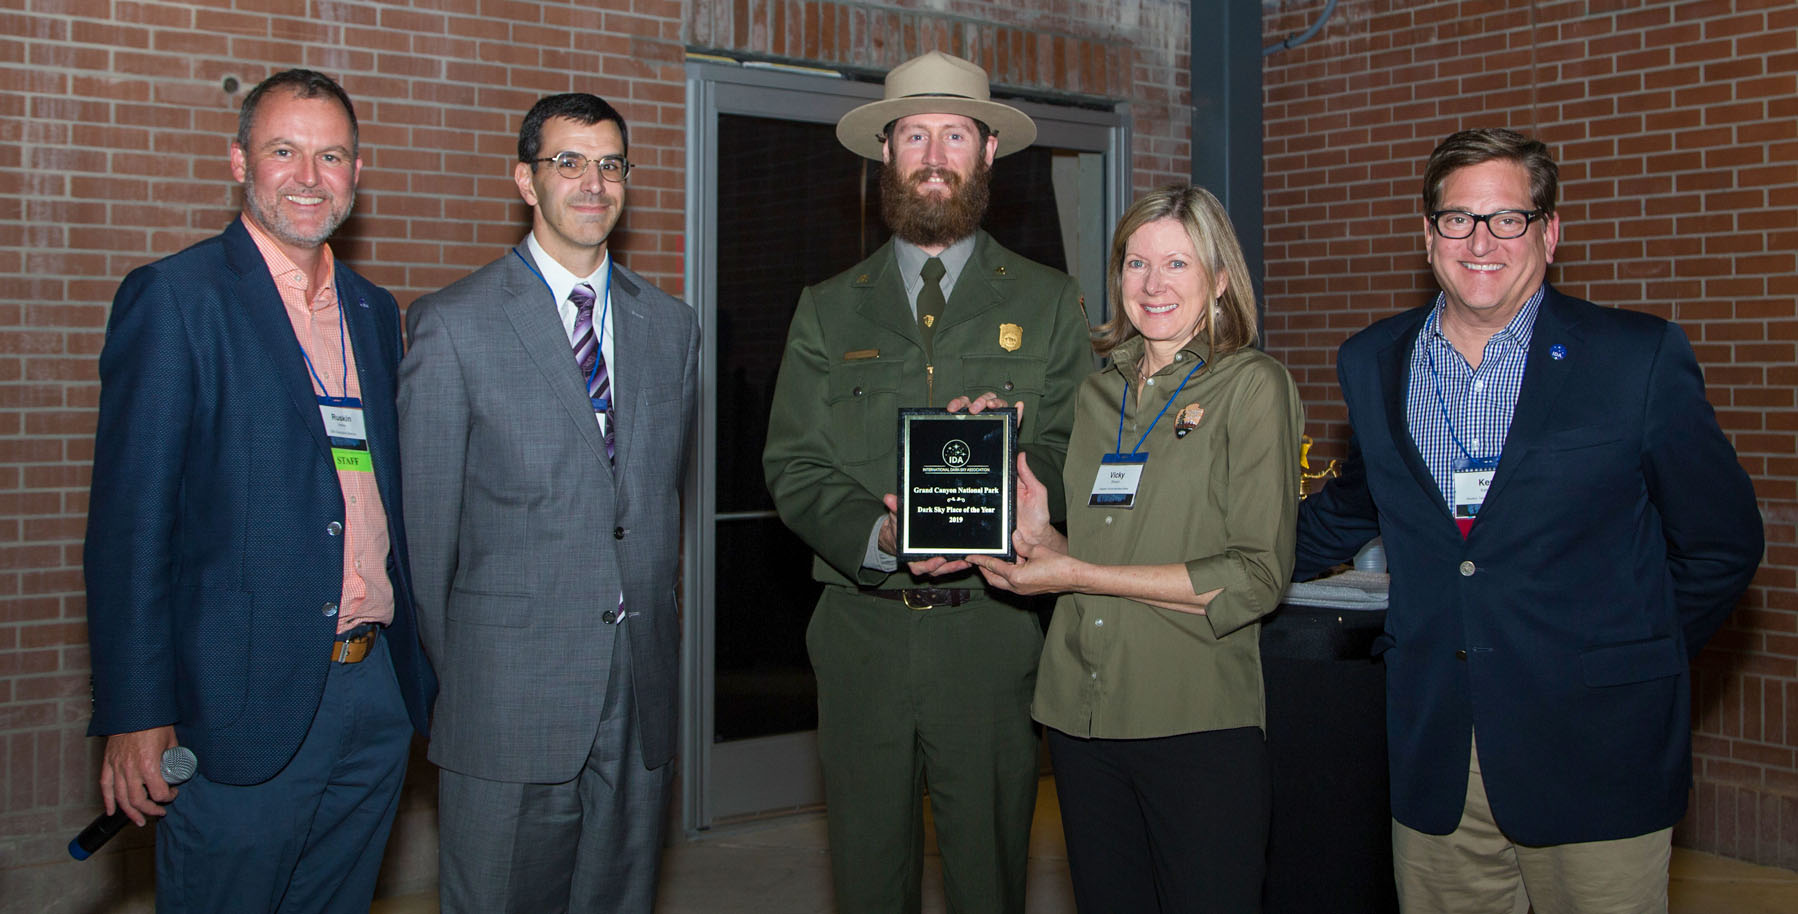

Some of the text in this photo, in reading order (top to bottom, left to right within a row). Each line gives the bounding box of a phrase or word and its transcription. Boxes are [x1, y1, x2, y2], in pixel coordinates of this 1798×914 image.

[331, 414, 352, 422] Ruskin
[337, 456, 359, 465] STAFF
[949, 456, 964, 464] IDA
[1110, 472, 1125, 480] Vicky
[934, 487, 957, 495] Canyon
[934, 506, 945, 514] Sky
